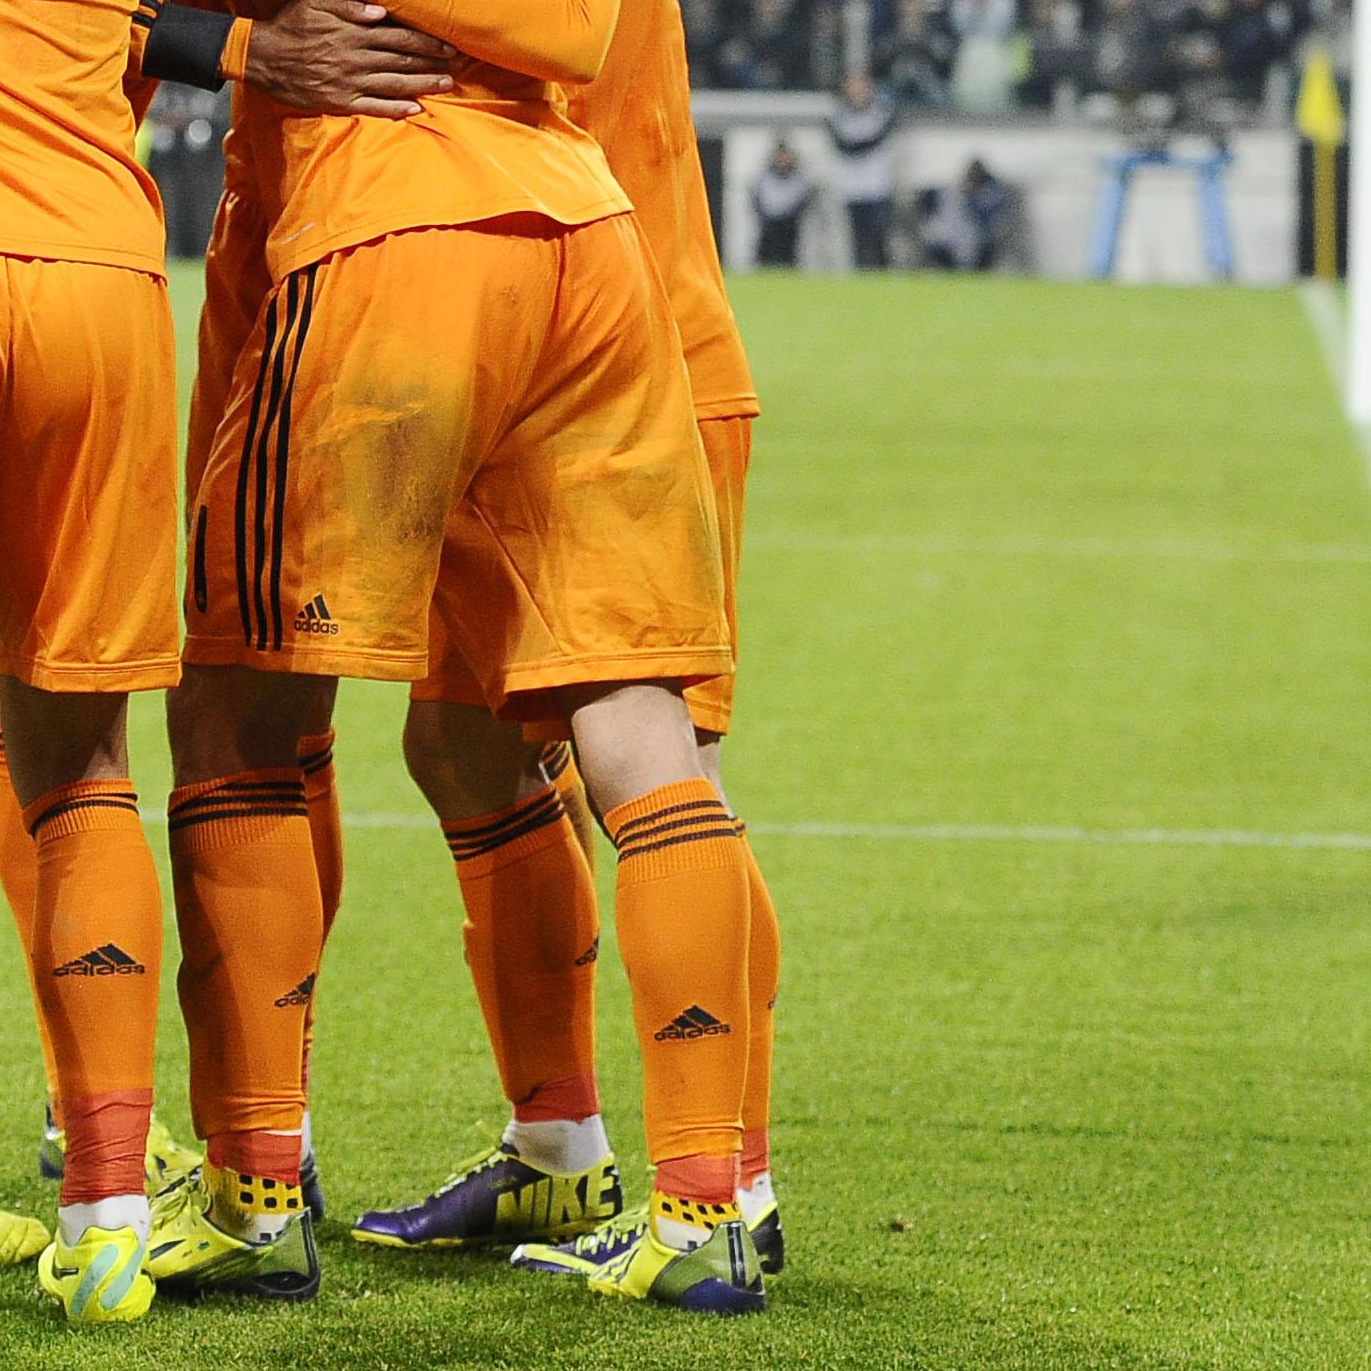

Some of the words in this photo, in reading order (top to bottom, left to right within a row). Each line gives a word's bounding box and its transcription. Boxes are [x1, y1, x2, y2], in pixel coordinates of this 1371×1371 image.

[294, 618, 339, 635] addas
[53, 961, 145, 977] adidas
[654, 1023, 731, 1041] adidas
[495, 1169, 615, 1229] NIKE
